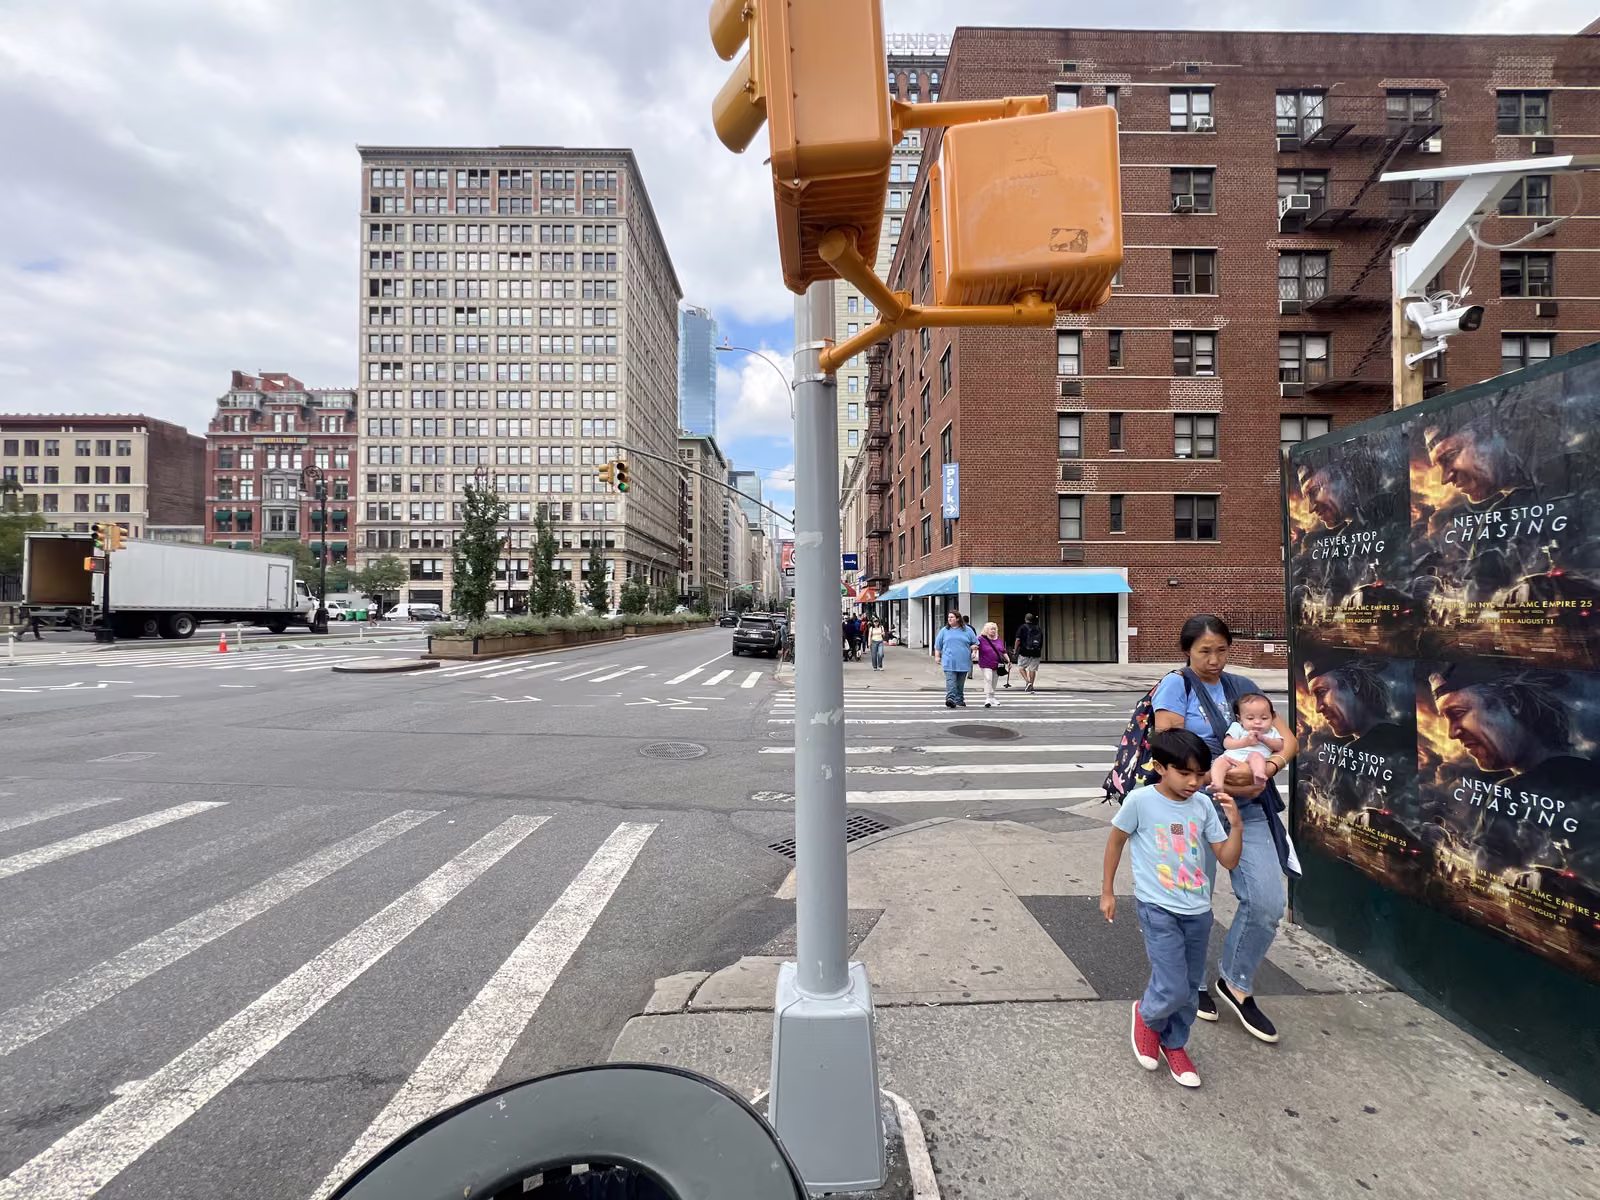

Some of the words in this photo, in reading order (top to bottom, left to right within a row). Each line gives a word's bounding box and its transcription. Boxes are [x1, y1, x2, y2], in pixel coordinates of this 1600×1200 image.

[946, 468, 956, 503] Park
[1444, 516, 1568, 544] CHASING
[1454, 511, 1502, 529] NEVER
[1511, 504, 1555, 520] STOP
[1312, 541, 1385, 560] CHASING
[1316, 535, 1347, 548] NEVER
[1351, 531, 1378, 543] STOP
[1318, 752, 1393, 782] CHASING
[1324, 742, 1354, 759] NEVER
[1358, 751, 1385, 766] STOP
[1462, 776, 1512, 800] NEVER
[1520, 792, 1566, 812] STOP
[1454, 788, 1579, 833] CHASING
[1528, 904, 1556, 920] AUGUST
[1531, 890, 1552, 902] AMC
[1556, 898, 1590, 917] EMPIRE
